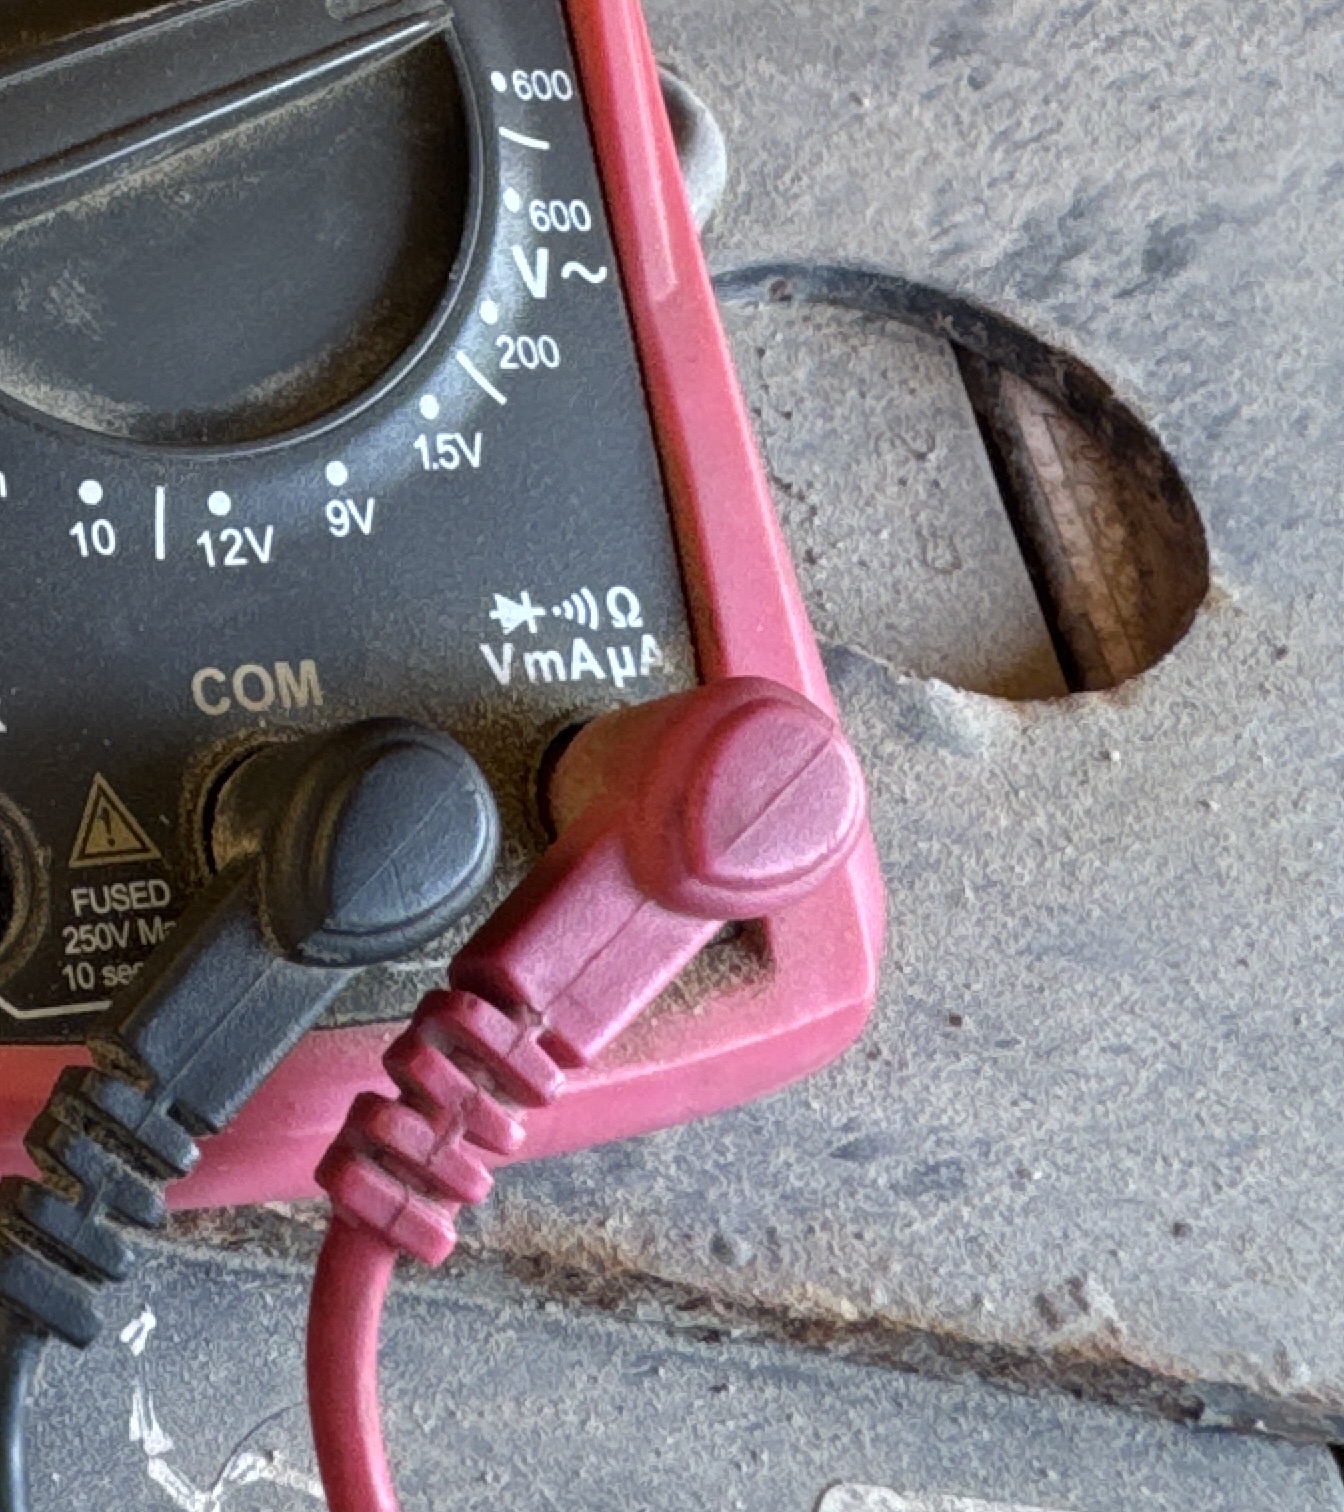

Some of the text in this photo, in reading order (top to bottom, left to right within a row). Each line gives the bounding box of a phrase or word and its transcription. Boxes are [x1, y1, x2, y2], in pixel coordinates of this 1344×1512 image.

[510, 68, 574, 102] 600
[528, 199, 593, 233] 600
[495, 333, 561, 371] 200
[412, 432, 483, 470] 1.5V
[324, 496, 376, 538] 9V
[69, 518, 117, 558] 10
[196, 524, 274, 568] 12V
[190, 657, 325, 716] COM
[70, 878, 172, 918] FUSED
[61, 918, 131, 956] 250V
[61, 960, 97, 992] 10
